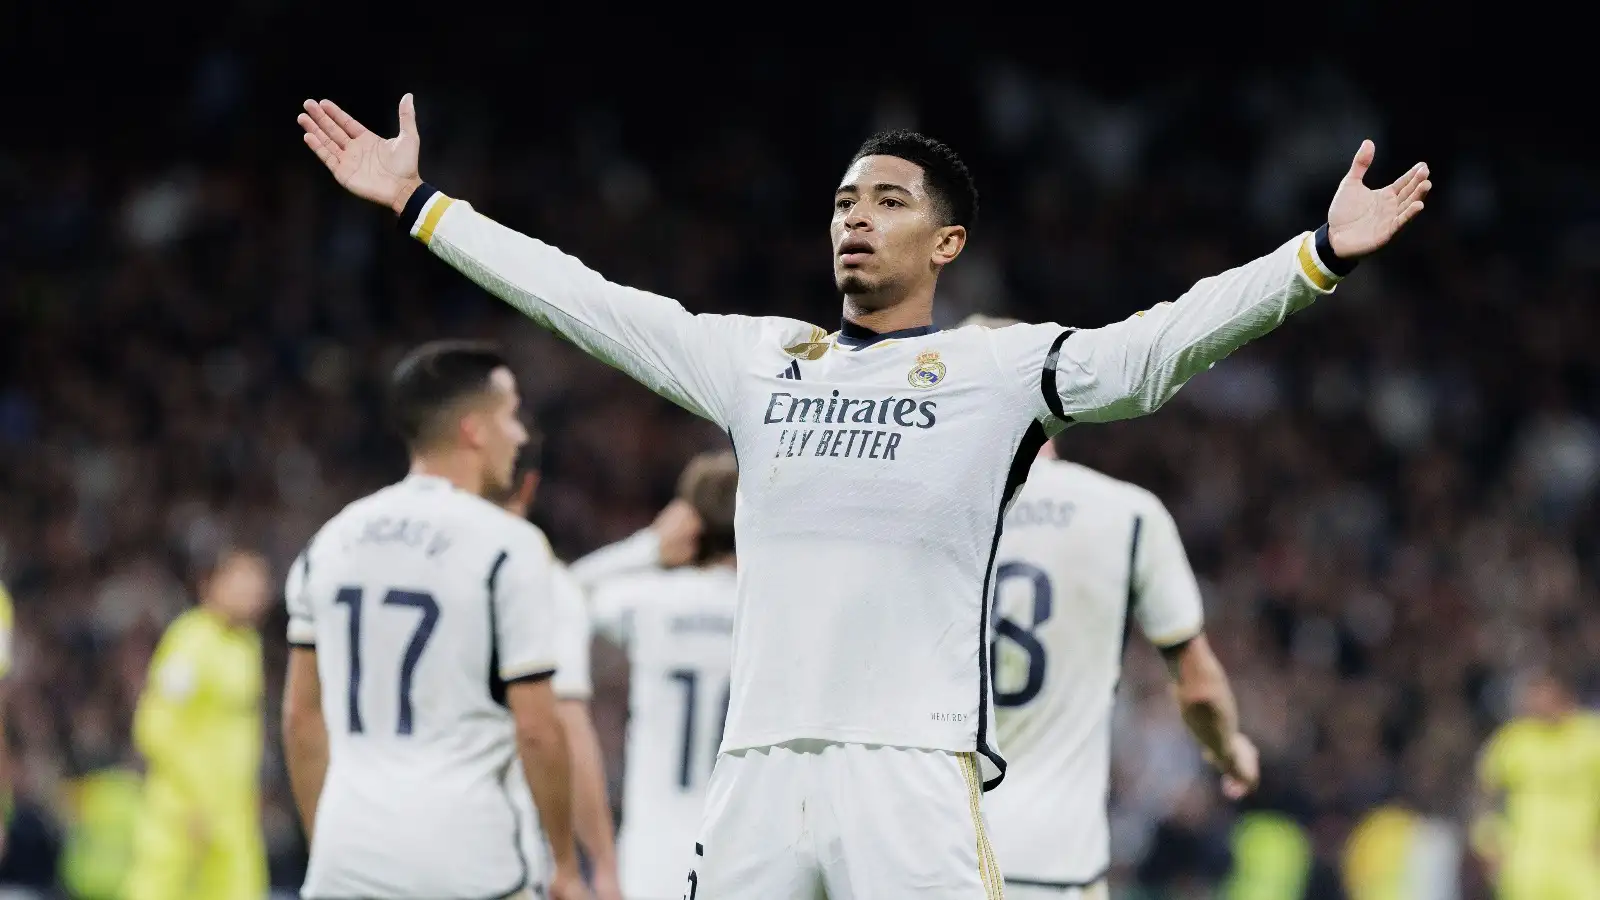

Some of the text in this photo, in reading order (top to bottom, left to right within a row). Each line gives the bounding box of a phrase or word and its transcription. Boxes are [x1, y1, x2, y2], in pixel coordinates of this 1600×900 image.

[764, 390, 937, 429] Emirates
[815, 430, 902, 460] BETTER
[335, 587, 440, 734] 17
[990, 562, 1053, 707] 8
